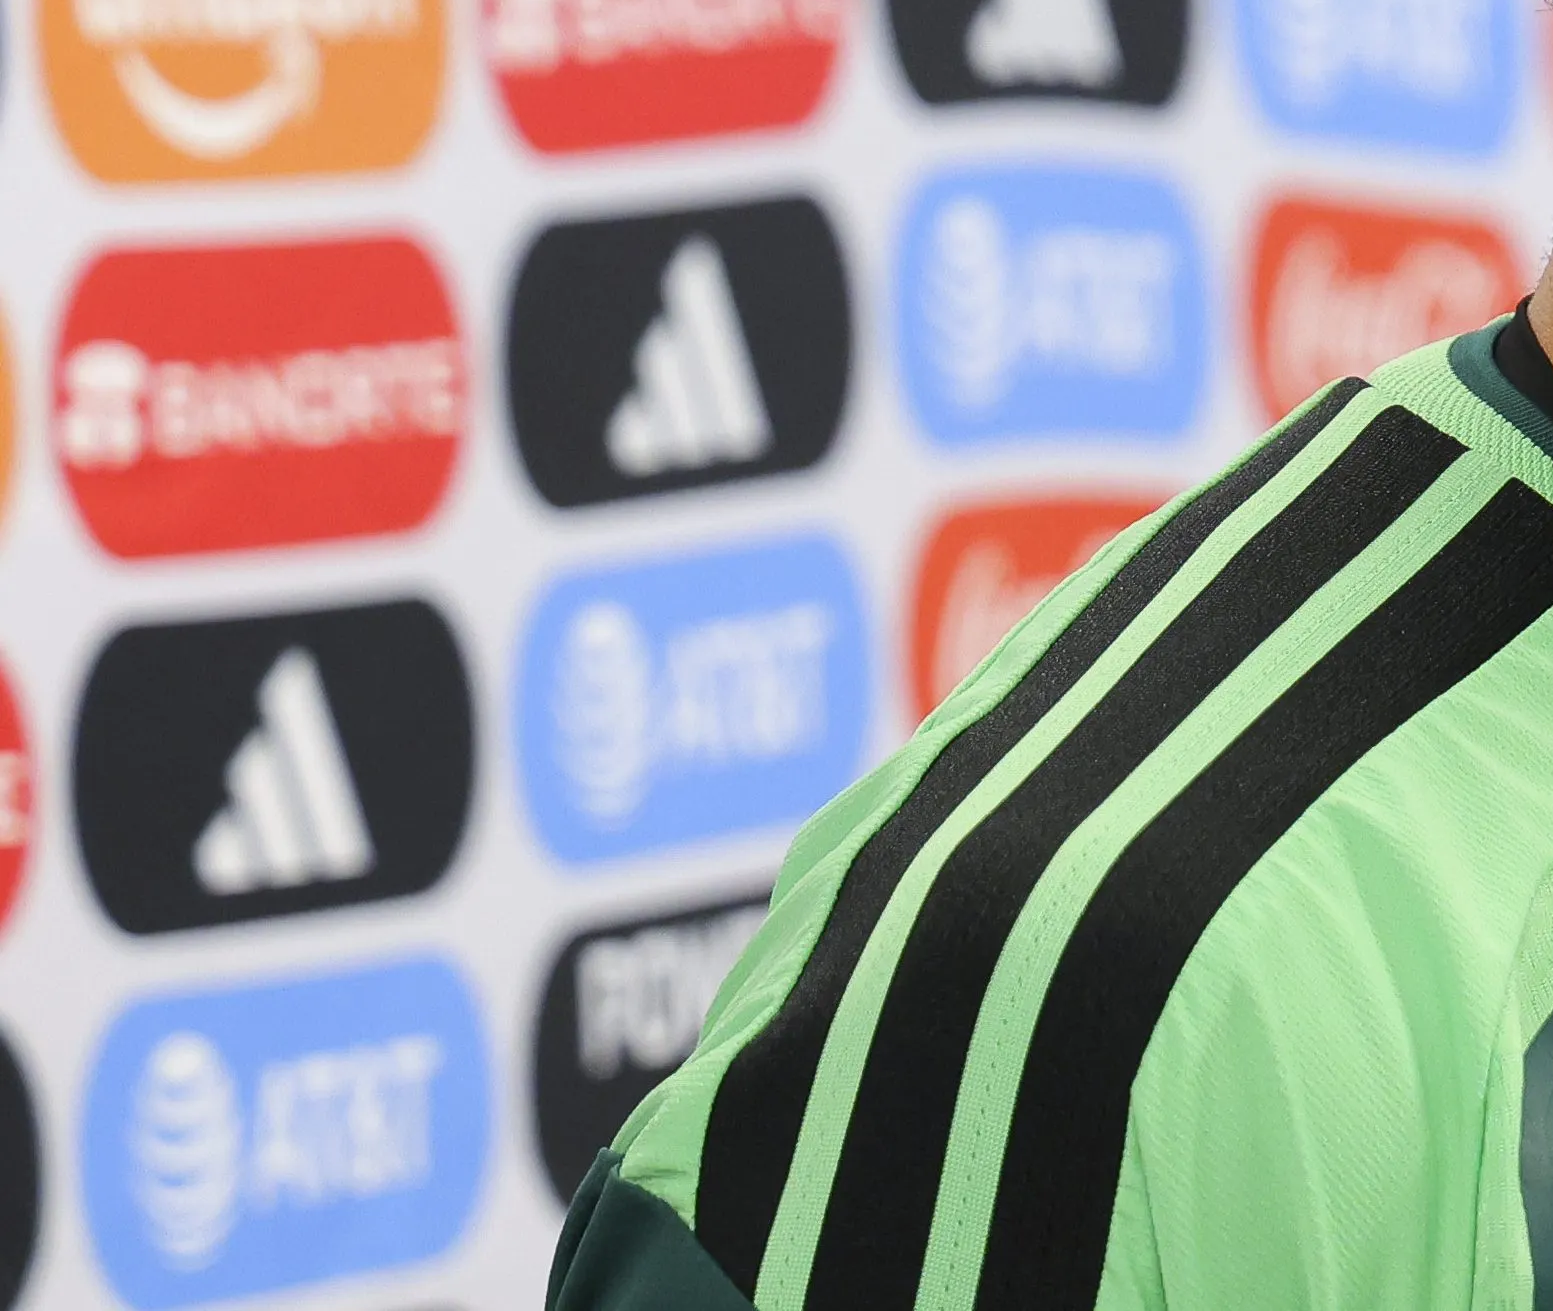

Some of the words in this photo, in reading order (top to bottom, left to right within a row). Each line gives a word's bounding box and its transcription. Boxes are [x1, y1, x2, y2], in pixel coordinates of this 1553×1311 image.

[152, 336, 460, 458] BANORTE
[660, 599, 832, 758] AT&T
[248, 1035, 442, 1208] AT&T
